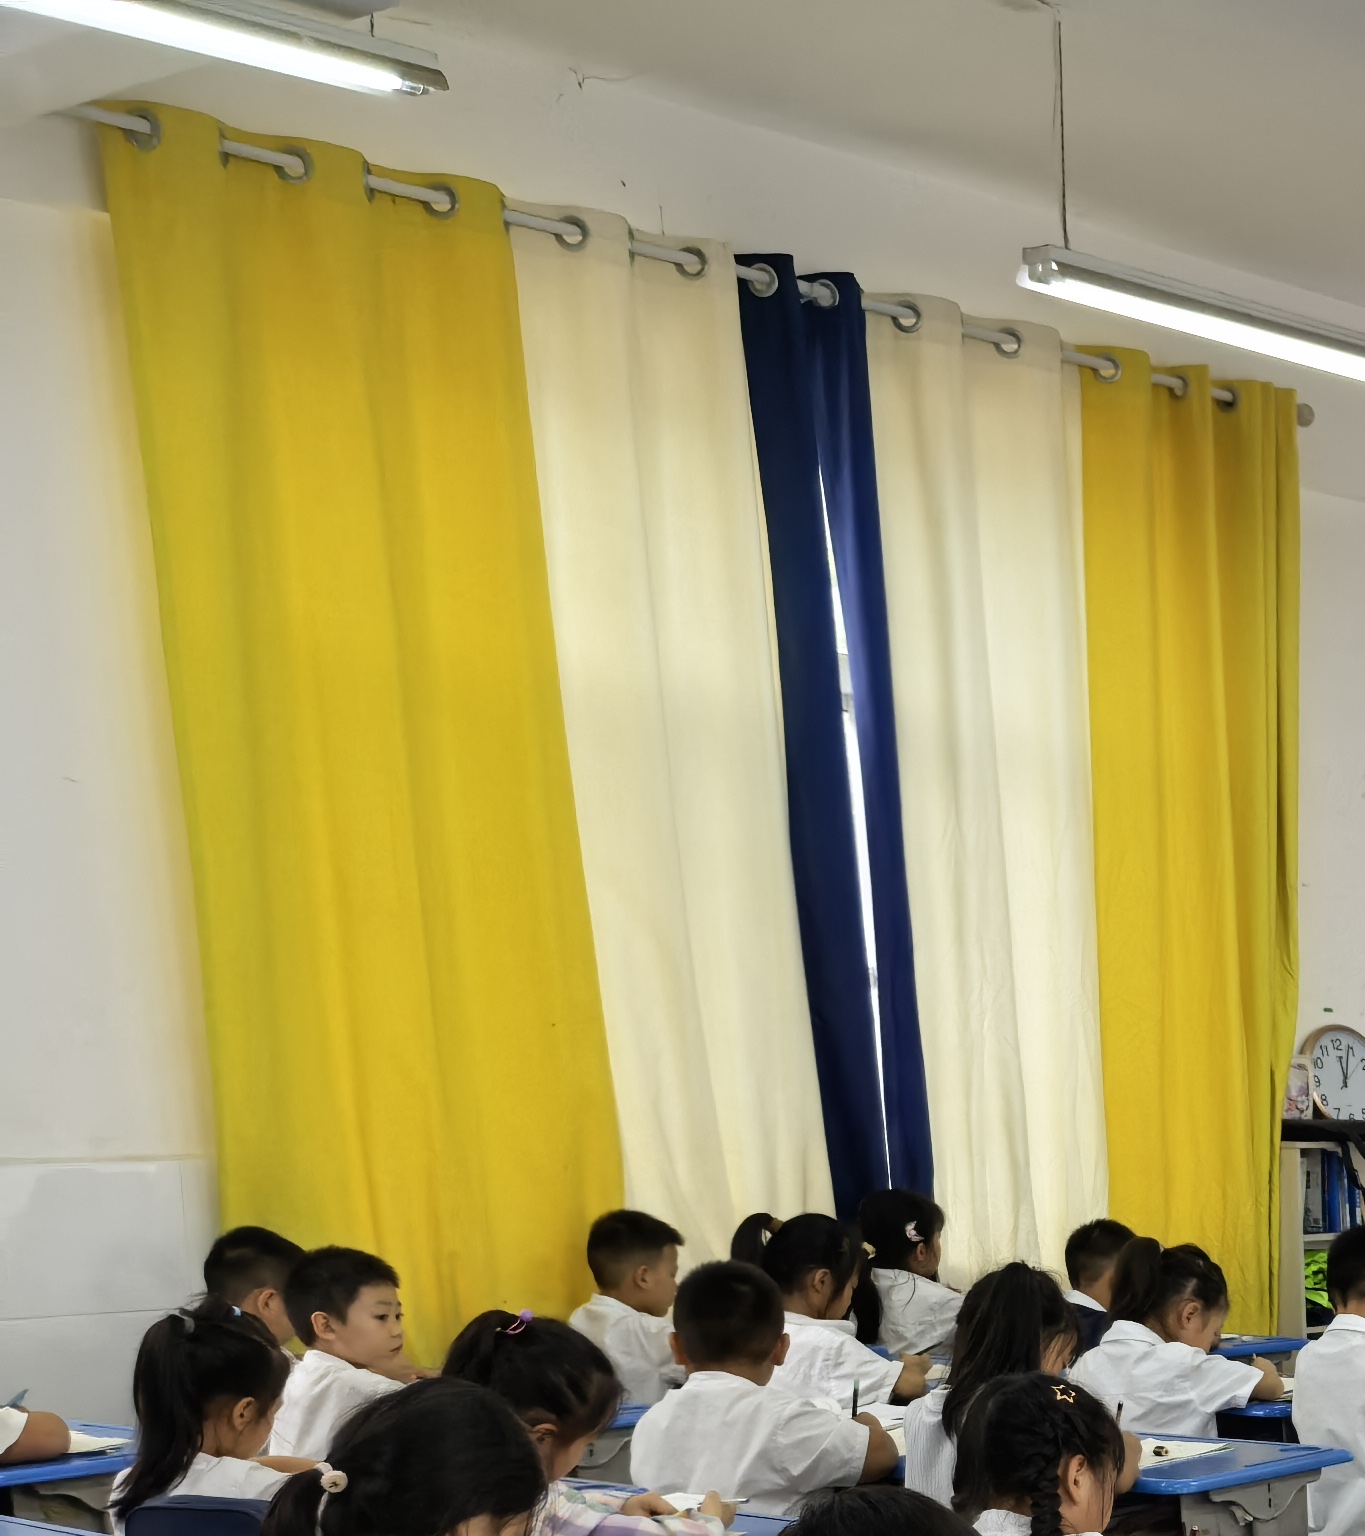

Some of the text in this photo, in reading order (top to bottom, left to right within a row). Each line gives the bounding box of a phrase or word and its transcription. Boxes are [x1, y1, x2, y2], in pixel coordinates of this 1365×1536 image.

[1320, 1045, 1329, 1057] 11
[1331, 1039, 1343, 1051] 12
[1349, 1046, 1355, 1057] 1
[1313, 1057, 1324, 1069] 10
[1313, 1075, 1321, 1088] 9
[1320, 1094, 1329, 1106] 8
[1333, 1108, 1340, 1120] 7
